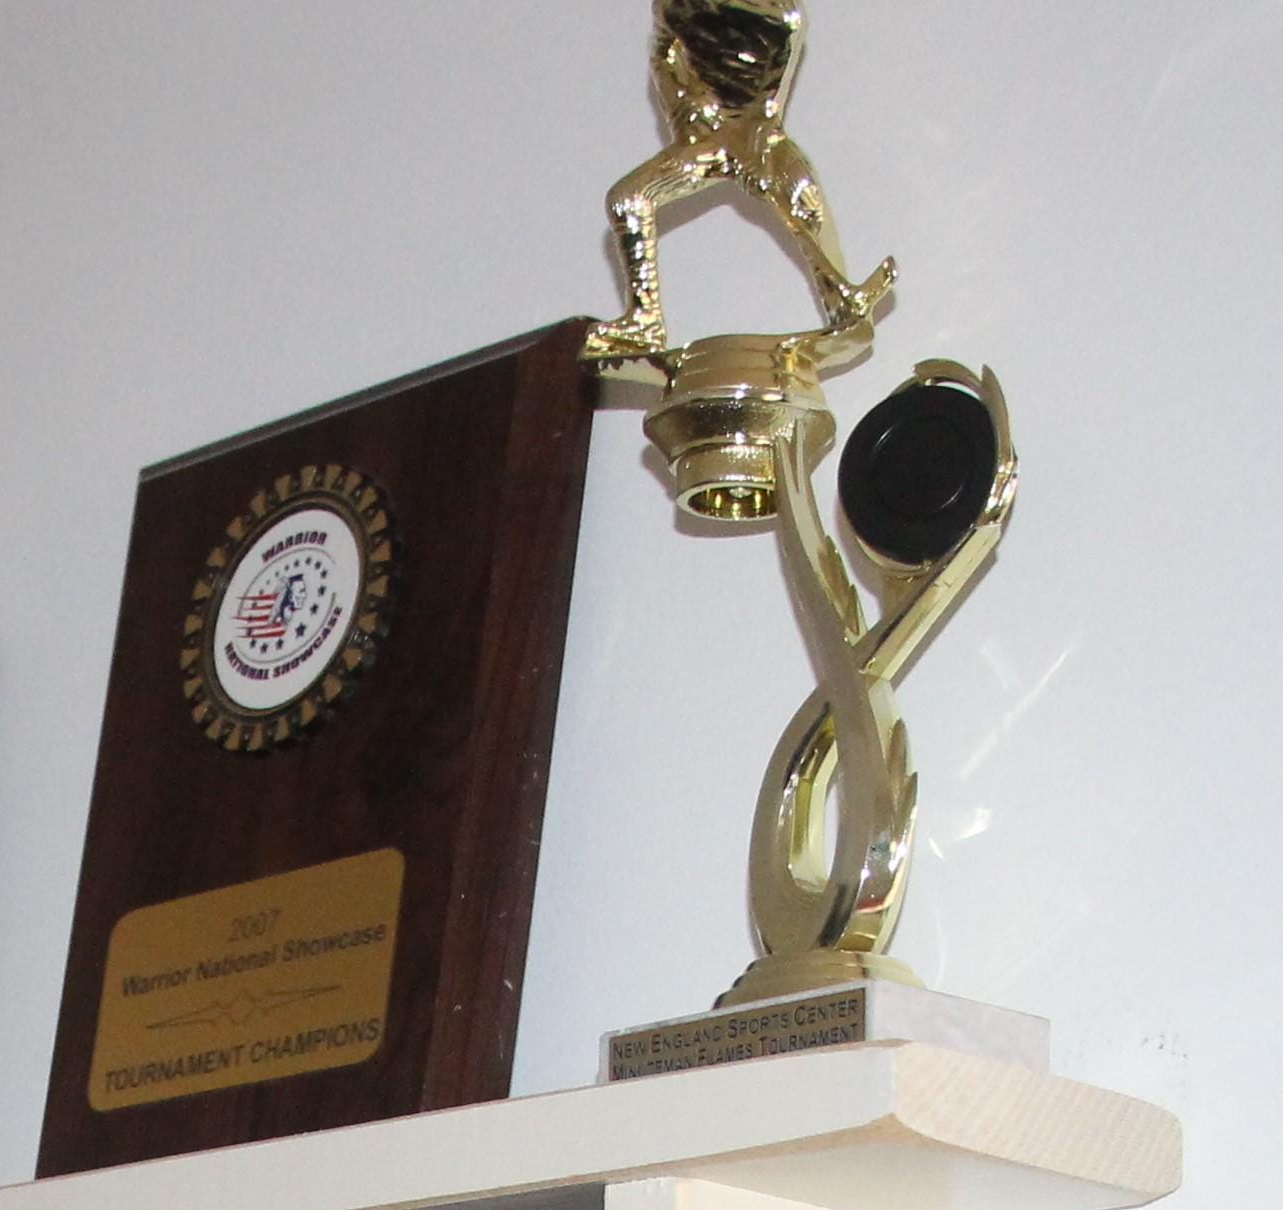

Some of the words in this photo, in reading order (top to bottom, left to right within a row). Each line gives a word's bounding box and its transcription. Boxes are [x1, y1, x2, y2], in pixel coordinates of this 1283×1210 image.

[261, 530, 328, 563] WARRIOR
[223, 640, 270, 681] NATIONAL
[273, 605, 343, 679] SHOWCASE
[228, 907, 282, 942] 2007
[122, 966, 192, 998] Warrior
[198, 946, 278, 981] National
[283, 922, 387, 963] Showcase
[105, 1044, 245, 1094] TOURNAMENT
[250, 1017, 382, 1065] CHAMPIONS
[612, 1040, 645, 1059] NEW
[651, 1026, 722, 1054] ENGLAND
[727, 1013, 788, 1039] SPORTS
[794, 999, 859, 1026] CENTER
[759, 1023, 858, 1056] TOURNAMENT
